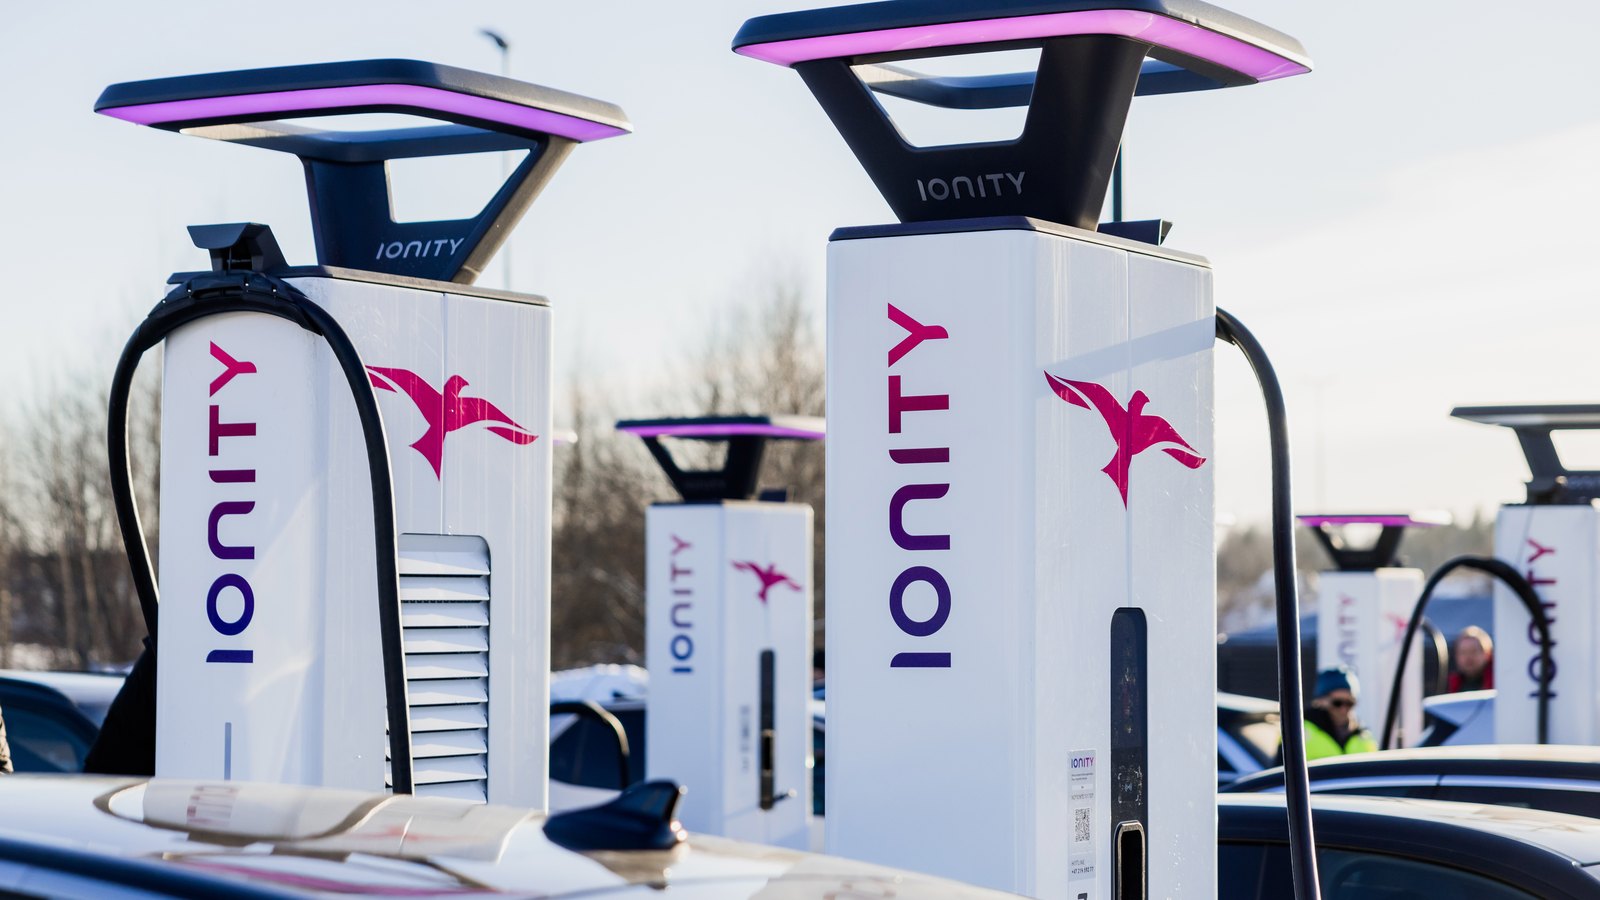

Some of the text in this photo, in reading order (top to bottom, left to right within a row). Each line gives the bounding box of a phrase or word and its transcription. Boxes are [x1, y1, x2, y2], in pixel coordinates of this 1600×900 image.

[917, 171, 1026, 202] IONITY
[376, 237, 465, 260] IONITY
[206, 340, 257, 664] IONITY
[887, 302, 952, 668] IONITY
[670, 533, 694, 674] IONITY
[1070, 757, 1095, 769] IONITY
